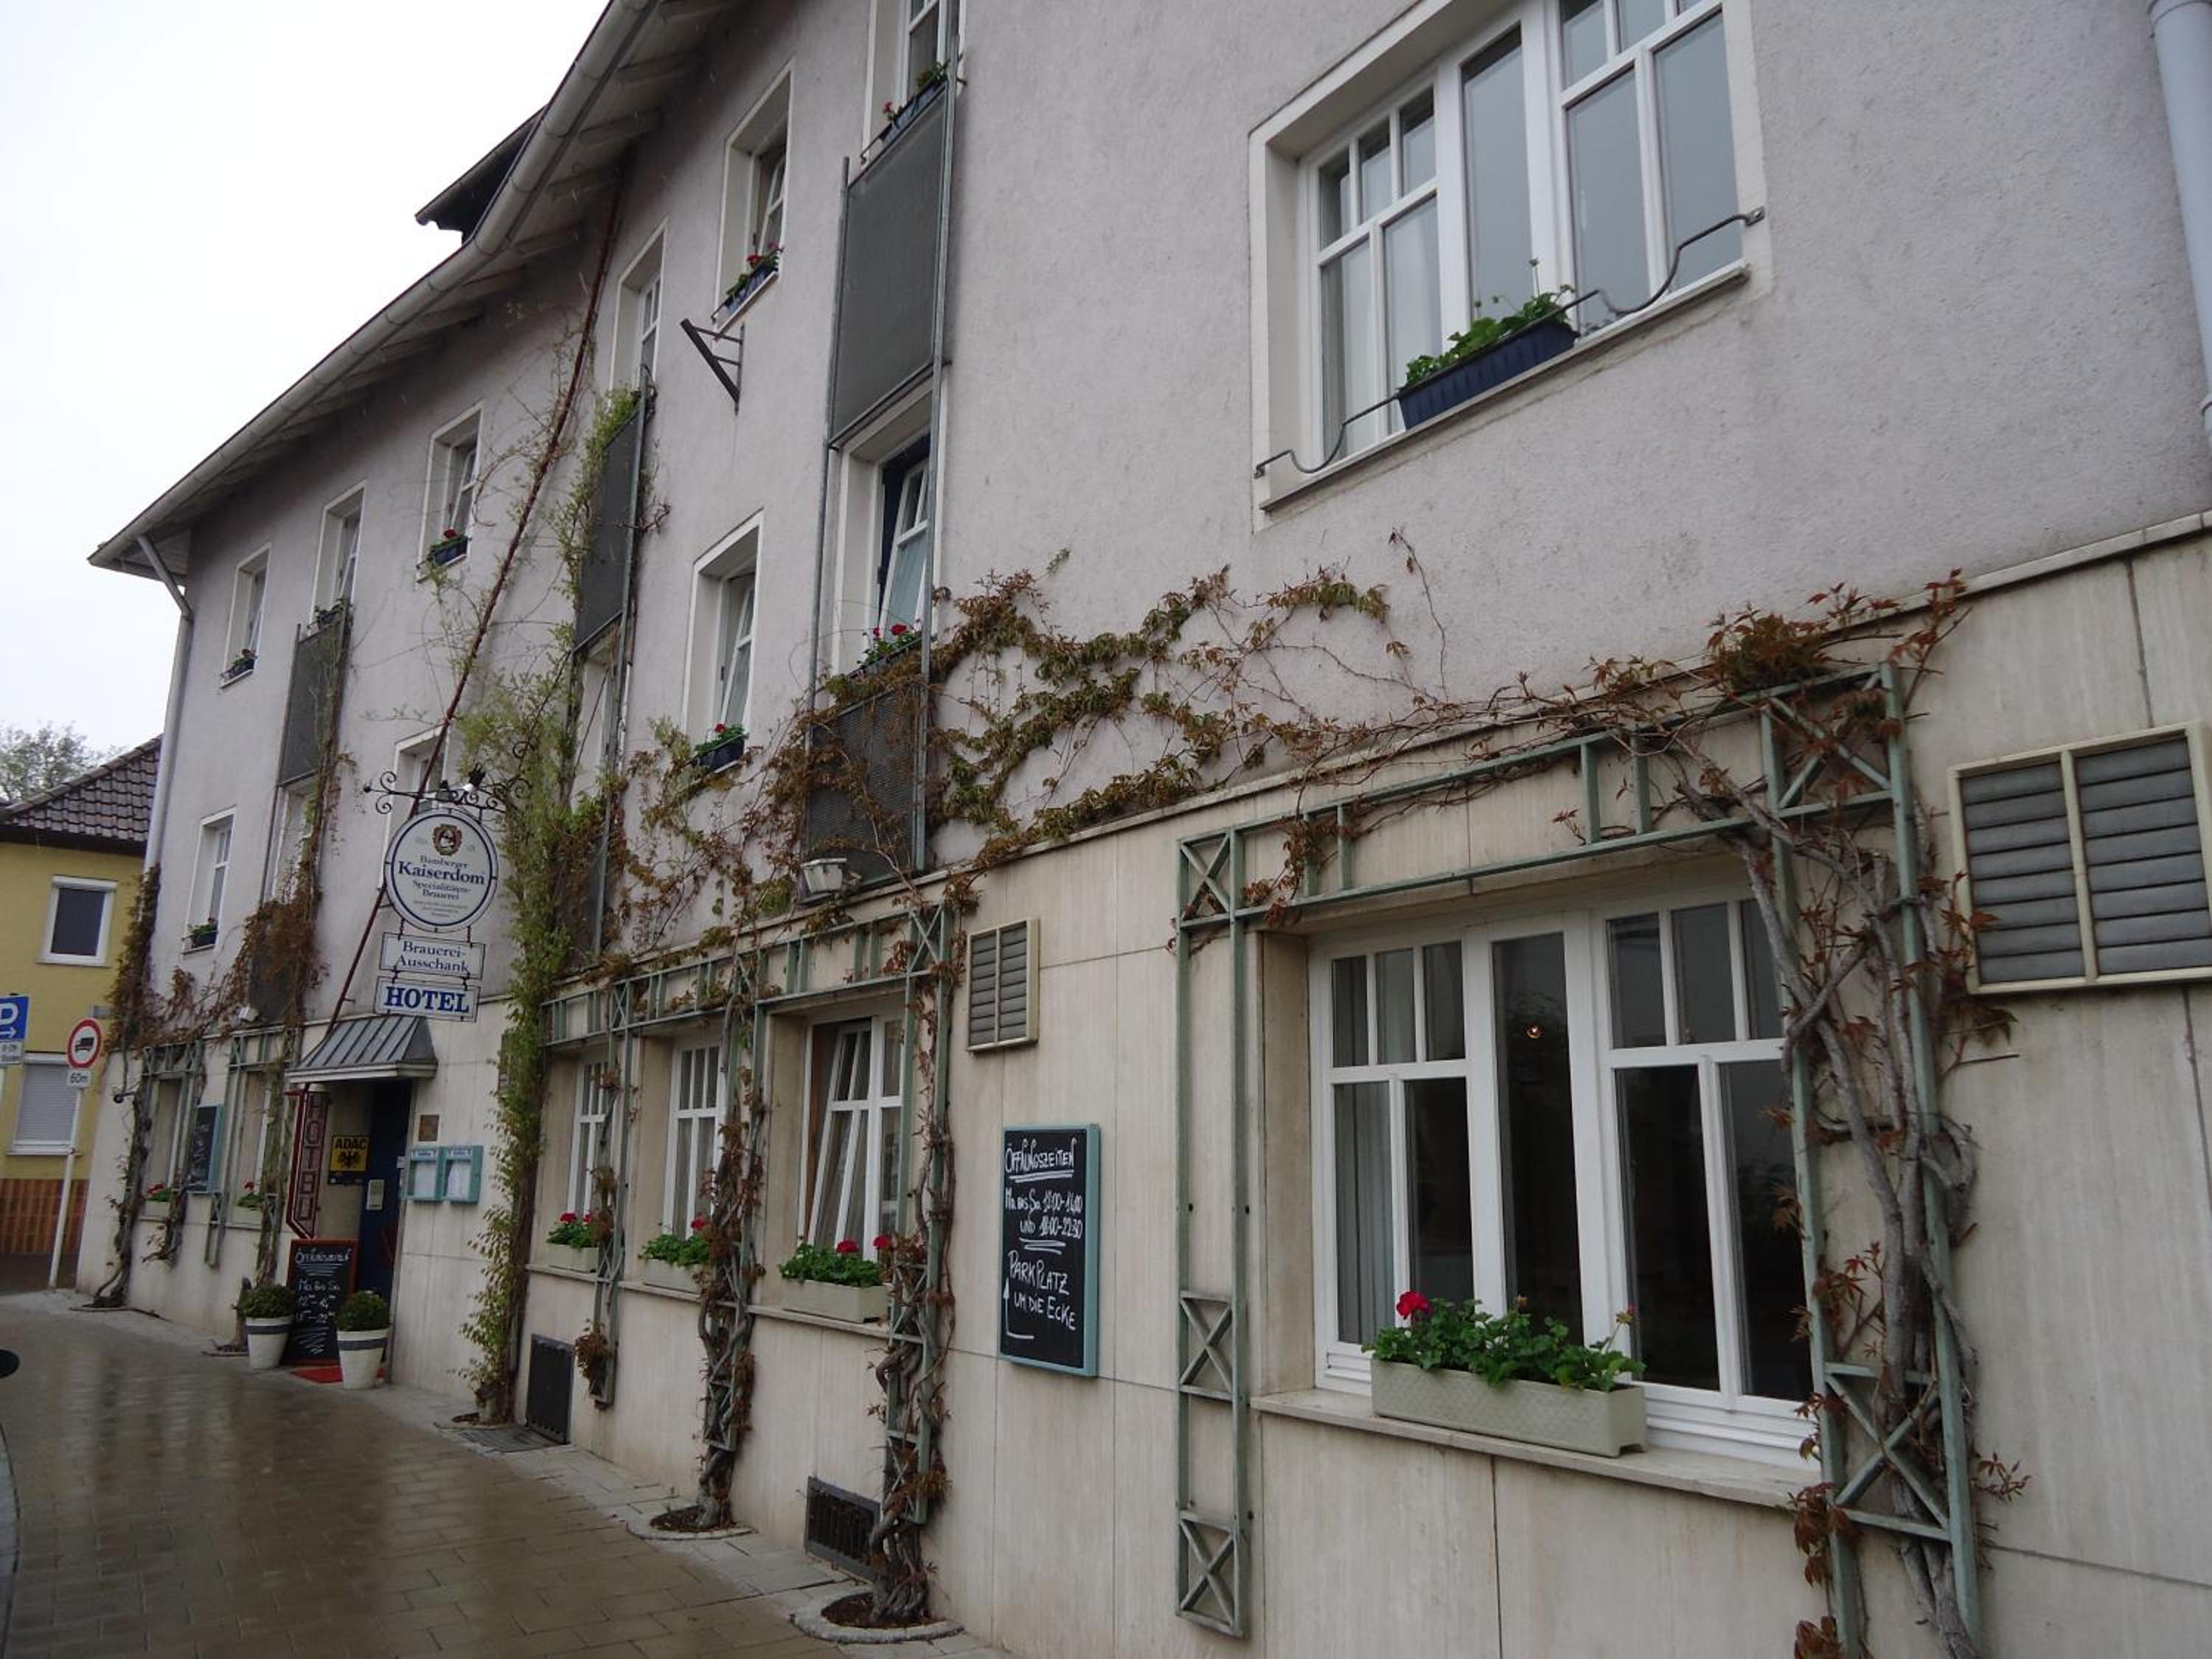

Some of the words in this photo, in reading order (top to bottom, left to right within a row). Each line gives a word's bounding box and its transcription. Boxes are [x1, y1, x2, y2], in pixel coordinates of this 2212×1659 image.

[398, 860, 485, 886] Kaiserdom
[422, 888, 459, 900] Brauerei
[403, 940, 467, 958] Brauerei-
[397, 954, 470, 973] Ausschank
[384, 986, 470, 1013] HOTEL
[334, 1138, 367, 1150] ADAC
